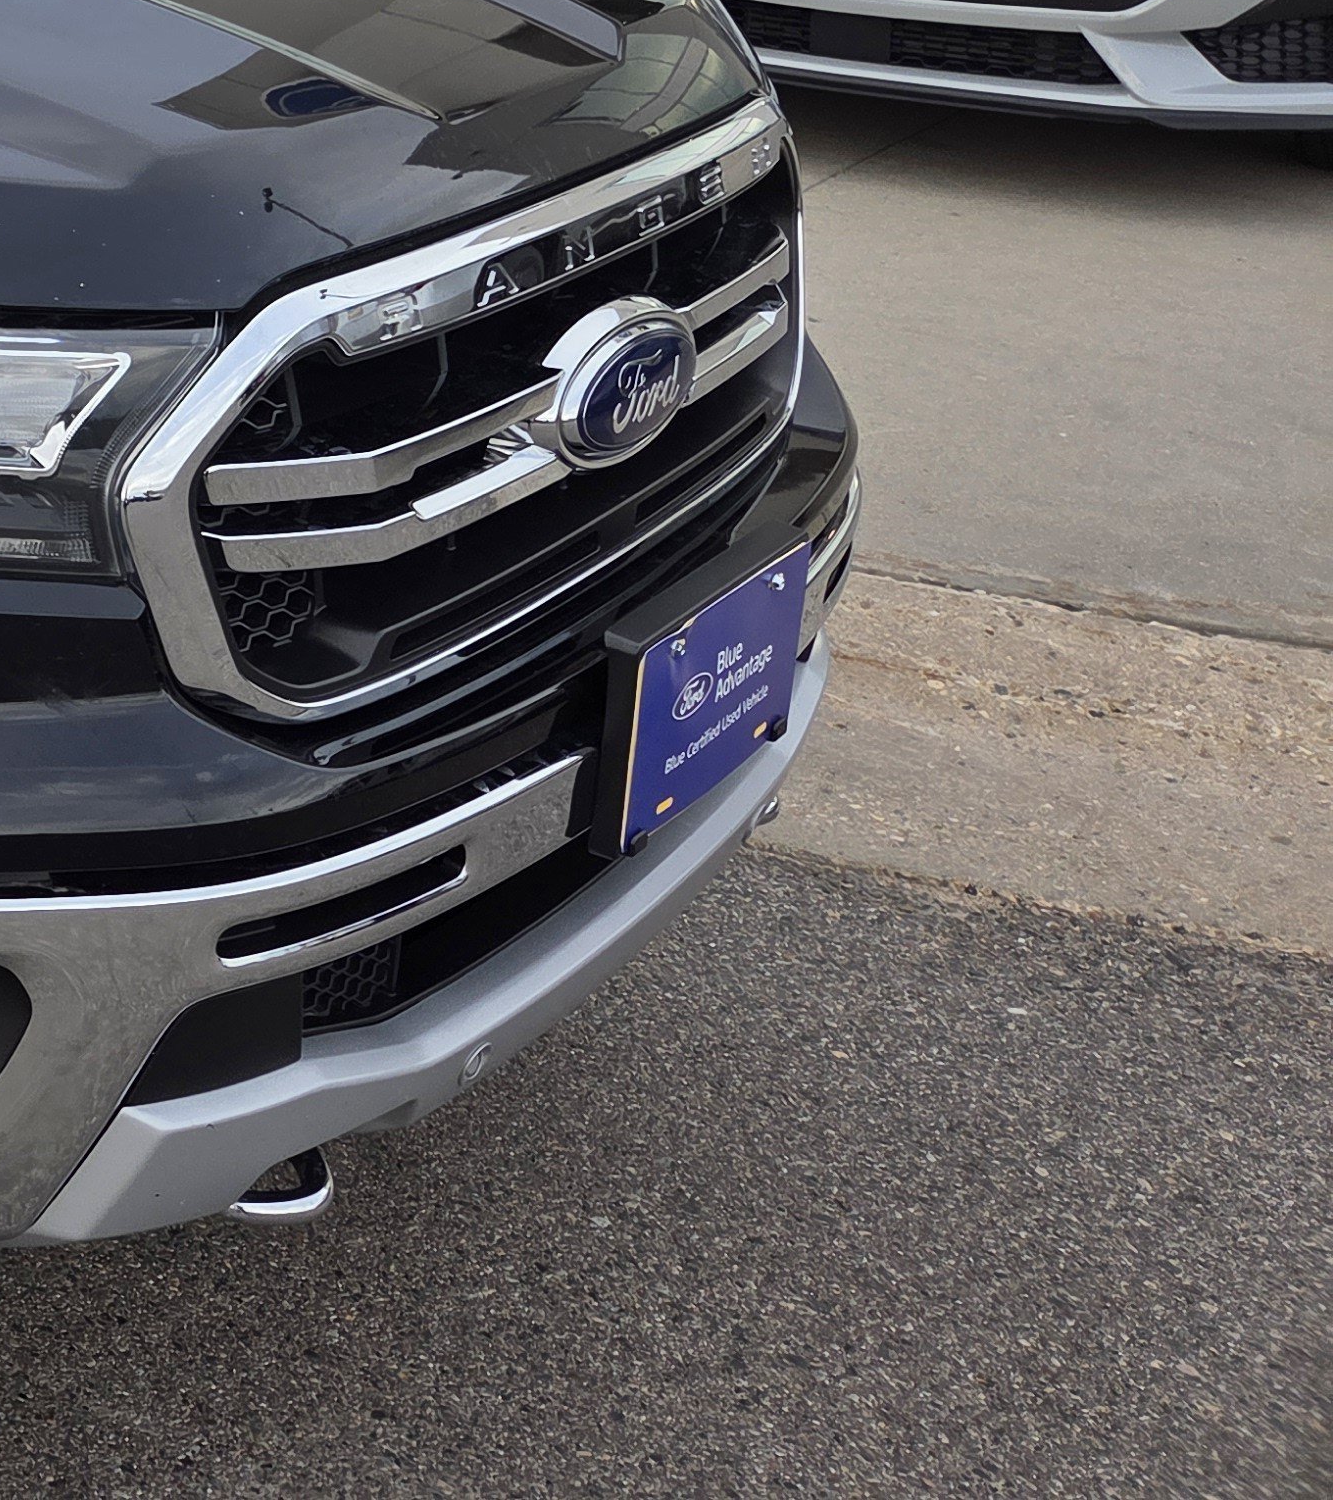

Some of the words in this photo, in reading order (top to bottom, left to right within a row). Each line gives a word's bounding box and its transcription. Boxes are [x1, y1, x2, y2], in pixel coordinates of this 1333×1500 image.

[379, 138, 772, 341] RANGER
[612, 347, 680, 435] Ford
[714, 645, 773, 703] Advantage
[717, 642, 744, 676] Blue
[664, 750, 686, 775] Blue
[686, 720, 721, 759] Certified
[721, 703, 742, 732] Used
[742, 684, 769, 714] Vehicle
[679, 680, 706, 716] Ford
